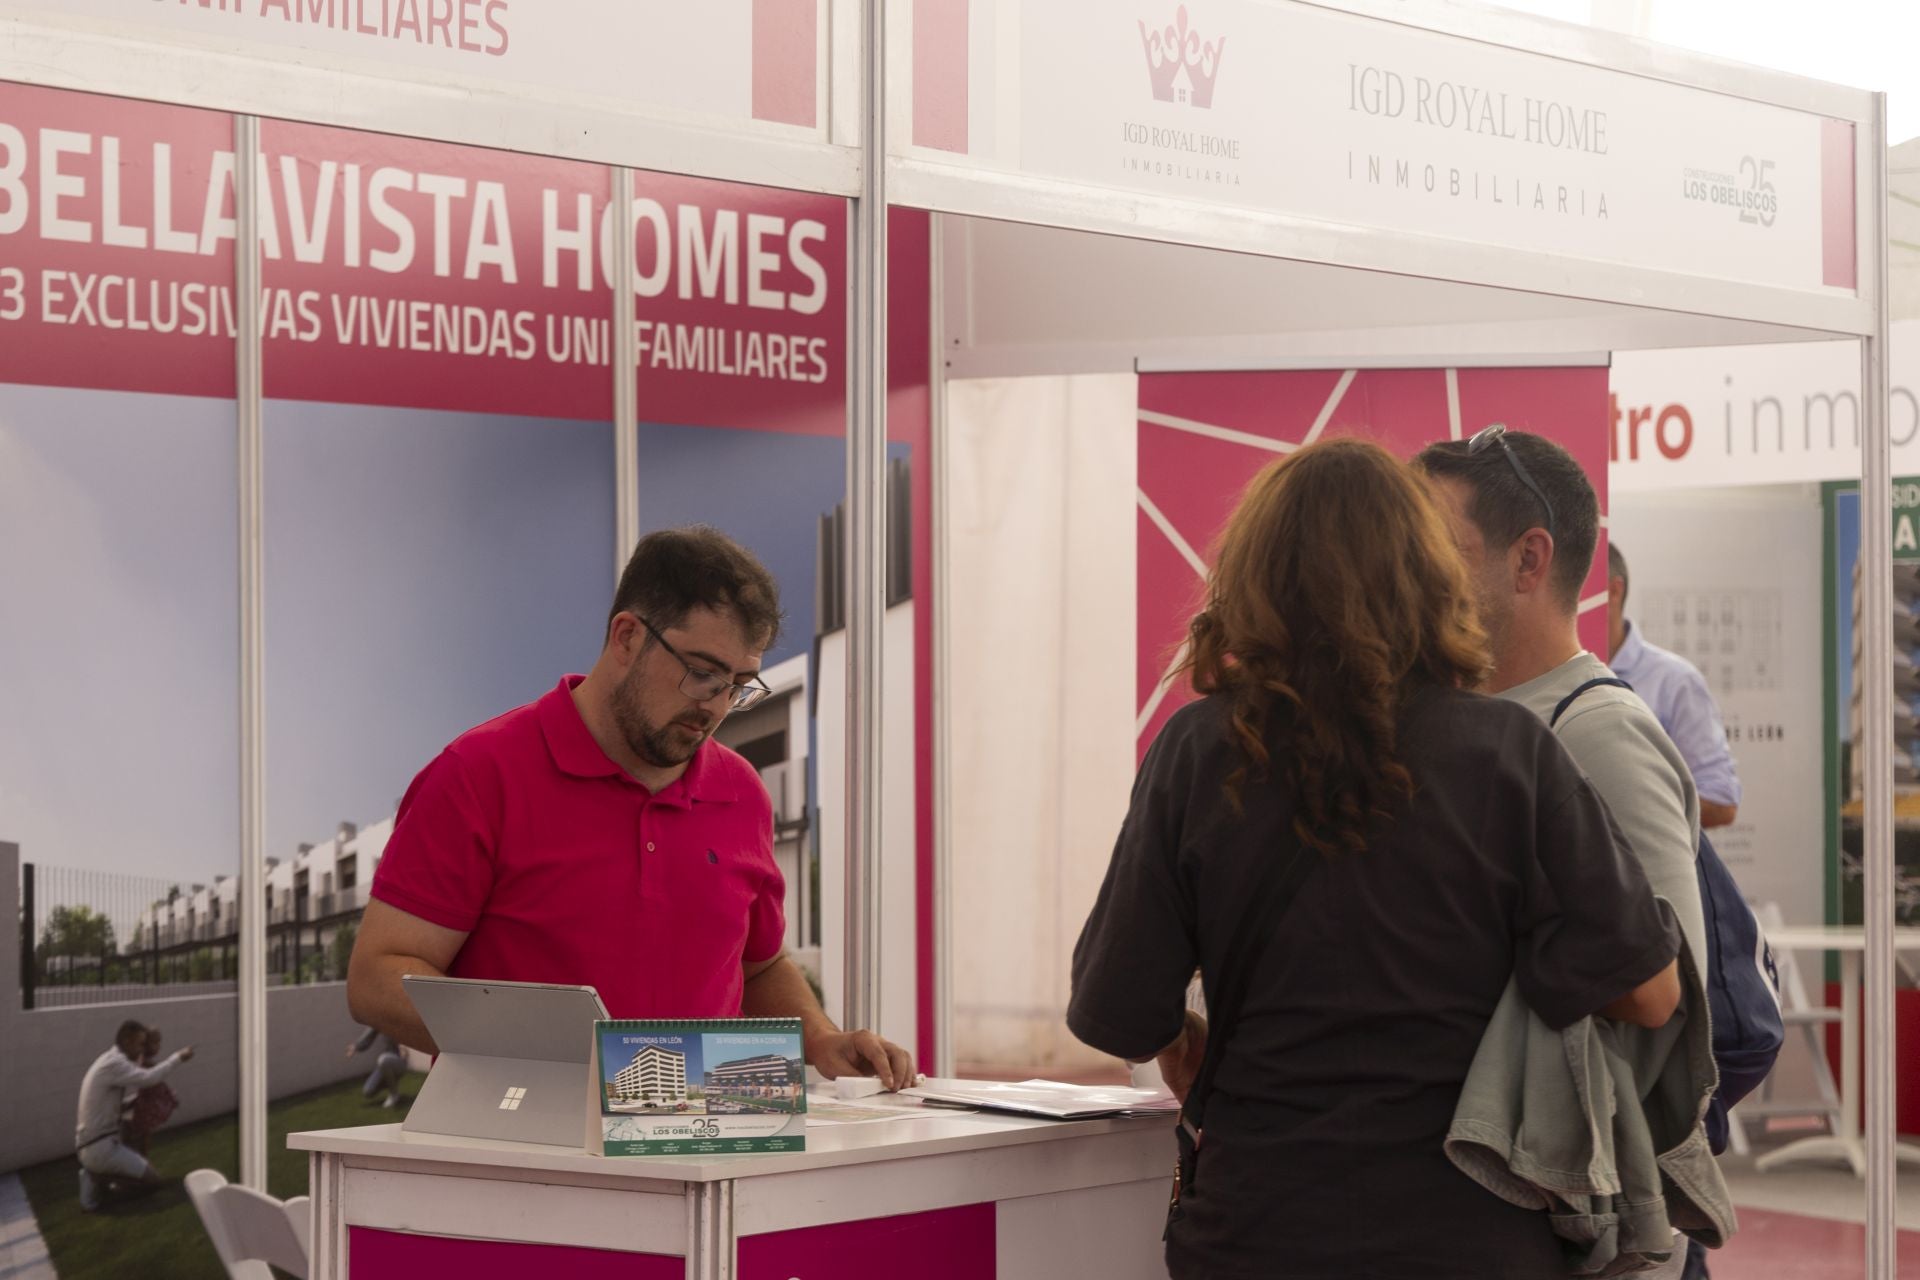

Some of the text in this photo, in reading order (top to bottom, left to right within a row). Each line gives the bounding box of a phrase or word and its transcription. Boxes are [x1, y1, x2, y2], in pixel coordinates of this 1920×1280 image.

[1347, 63, 1609, 155] IGD ROYAL HOME
[1123, 122, 1241, 160] IGD ROYAL HOME
[1122, 157, 1241, 186] INMOBILIARIA
[1348, 150, 1609, 221] INMOBILIARIA
[1683, 179, 1778, 214] LOS OBELISCOS
[1738, 155, 1776, 228] 25
[542, 188, 828, 315] HOMES
[42, 269, 322, 343] EXCLUSIVAS
[331, 293, 537, 360] VIVIENDAS
[672, 1127, 720, 1135] OBELISCOS
[692, 1118, 719, 1138] 25
